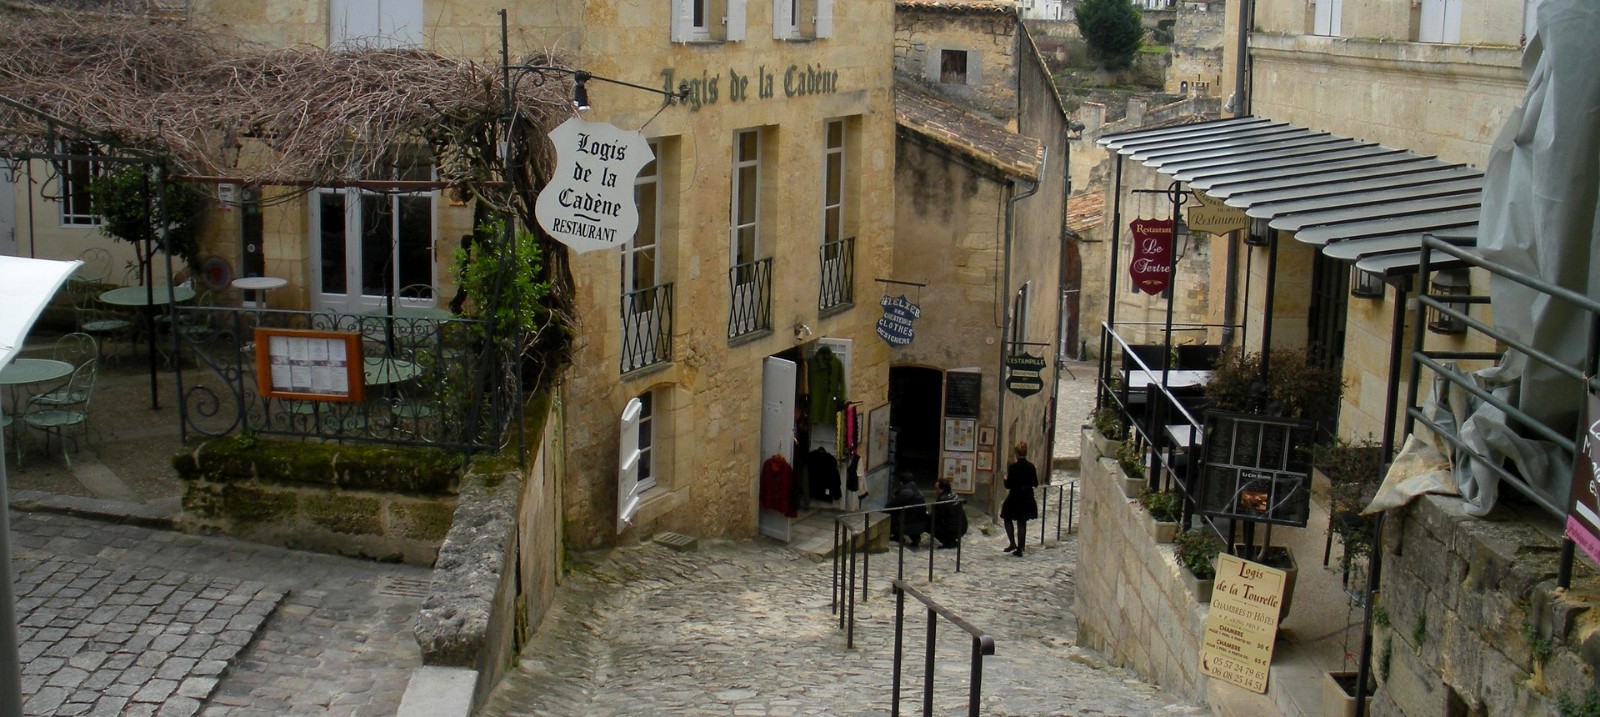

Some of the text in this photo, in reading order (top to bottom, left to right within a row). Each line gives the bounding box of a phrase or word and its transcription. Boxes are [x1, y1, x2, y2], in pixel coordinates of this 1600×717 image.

[660, 67, 719, 112] Logis
[730, 67, 748, 102] de
[758, 64, 774, 99] la
[576, 132, 628, 161] Logis
[573, 161, 618, 188] de la
[558, 187, 622, 218] Cadène
[552, 218, 618, 243] RESTAURANT
[1142, 238, 1164, 254] Le
[1134, 258, 1171, 274] Tertre
[876, 326, 910, 345] DESIGNERS
[878, 318, 914, 337] CLOTHES
[1238, 561, 1264, 580] Logis
[1216, 580, 1278, 608] de la Tourelle
[1218, 624, 1244, 638] CHAMBRE
[1216, 639, 1240, 652] CHAMBRE
[1212, 667, 1222, 676] 06
[1222, 670, 1232, 680] 08
[1234, 674, 1243, 684] 25
[1224, 660, 1233, 669] 57
[1234, 664, 1244, 673] 24
[1245, 667, 1254, 676] 79
[1255, 672, 1264, 680] 65
